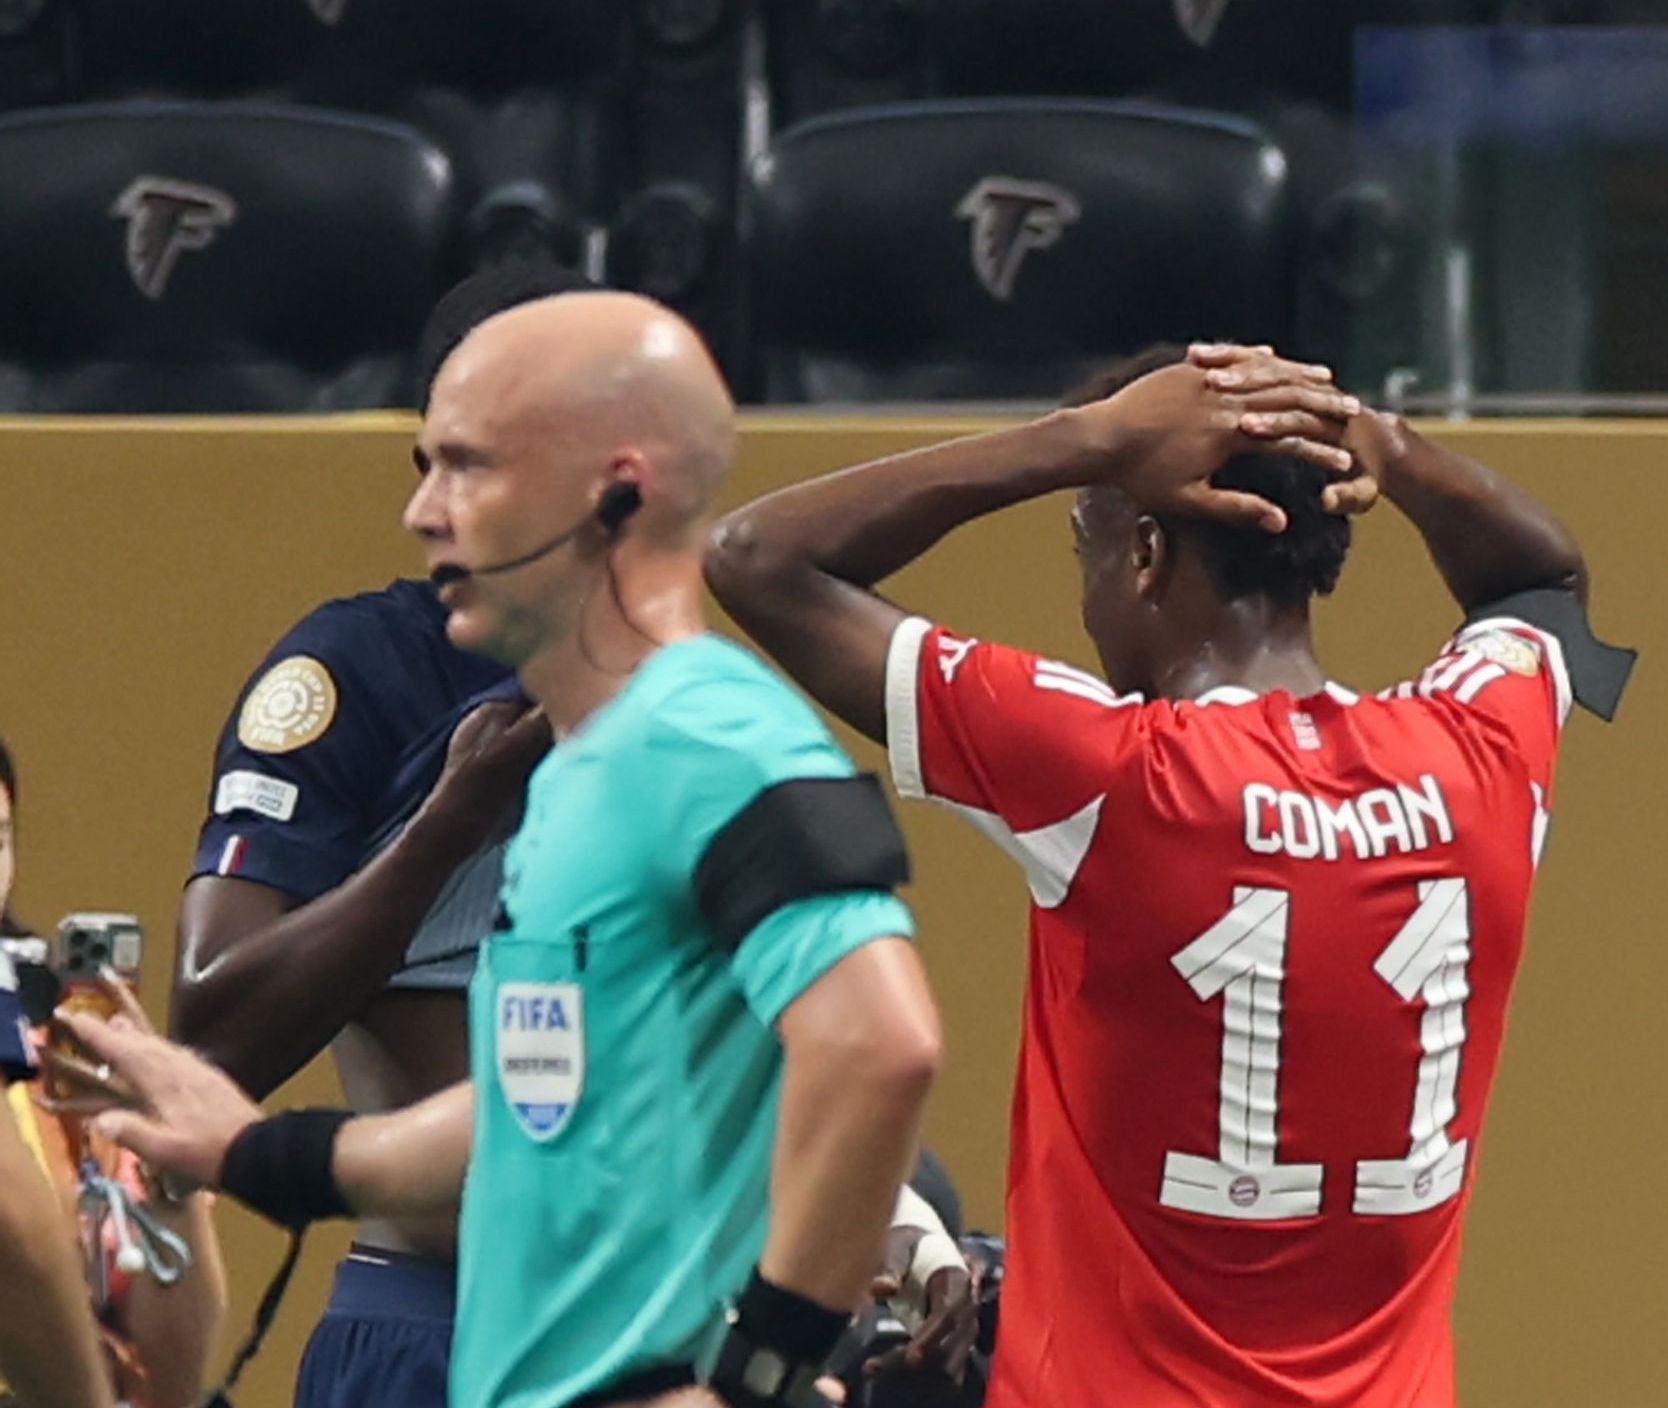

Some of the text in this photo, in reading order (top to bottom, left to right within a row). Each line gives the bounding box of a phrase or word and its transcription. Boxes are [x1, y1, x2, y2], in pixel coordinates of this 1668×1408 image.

[1241, 774, 1453, 861] COMAN
[503, 996, 570, 1030] FIFA
[1159, 876, 1470, 1220] 11
